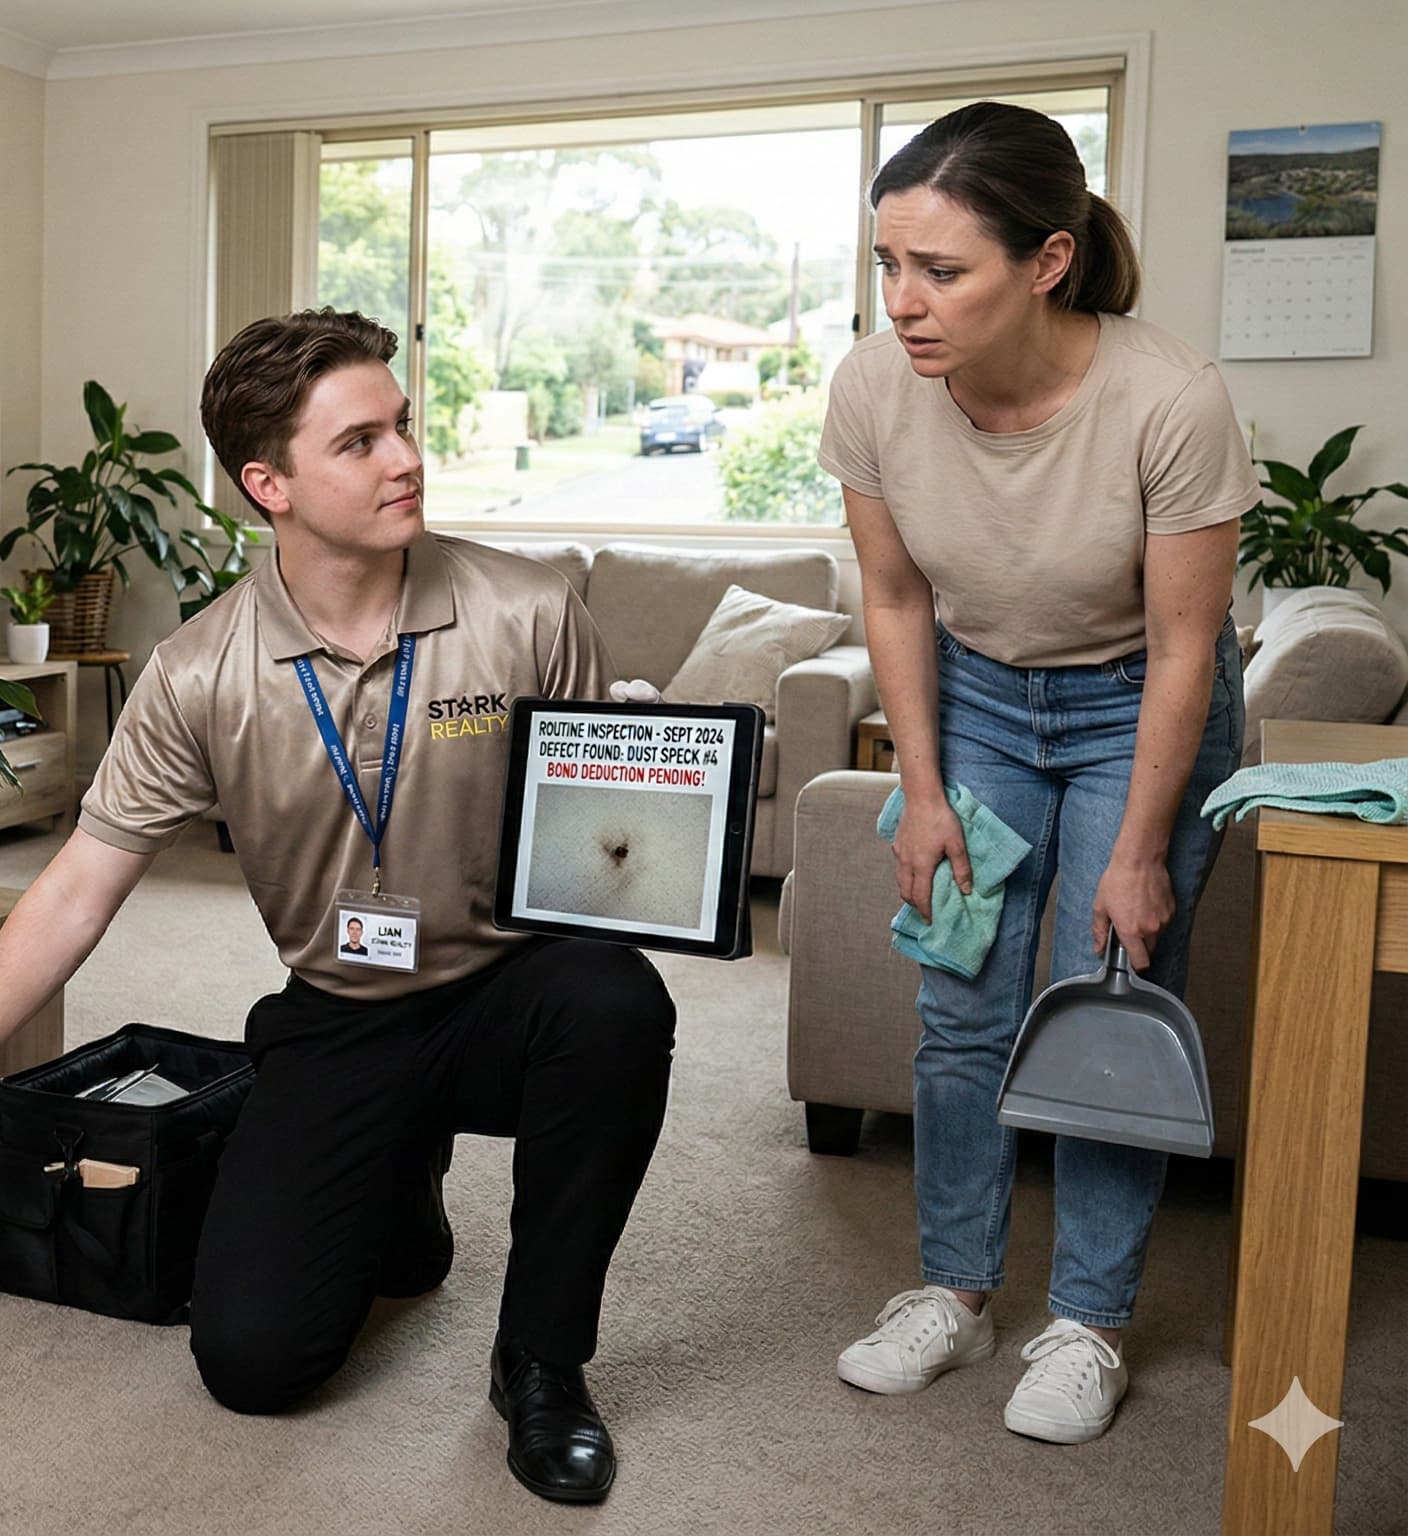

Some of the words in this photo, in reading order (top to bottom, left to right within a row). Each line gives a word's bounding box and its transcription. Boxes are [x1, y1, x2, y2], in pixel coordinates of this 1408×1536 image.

[428, 692, 508, 719] STARK
[430, 714, 508, 740] REALTY
[538, 720, 584, 738] ROUTINE
[587, 722, 653, 742] INSPECTION
[663, 726, 692, 744] SEPT
[539, 741, 581, 759] DEFECT
[582, 743, 624, 761] FOUND:
[627, 745, 657, 763] DUST
[660, 747, 700, 765] SPECK
[547, 762, 578, 779] BOND
[581, 763, 644, 783] DEDUCTION
[648, 767, 706, 787] PENDING!
